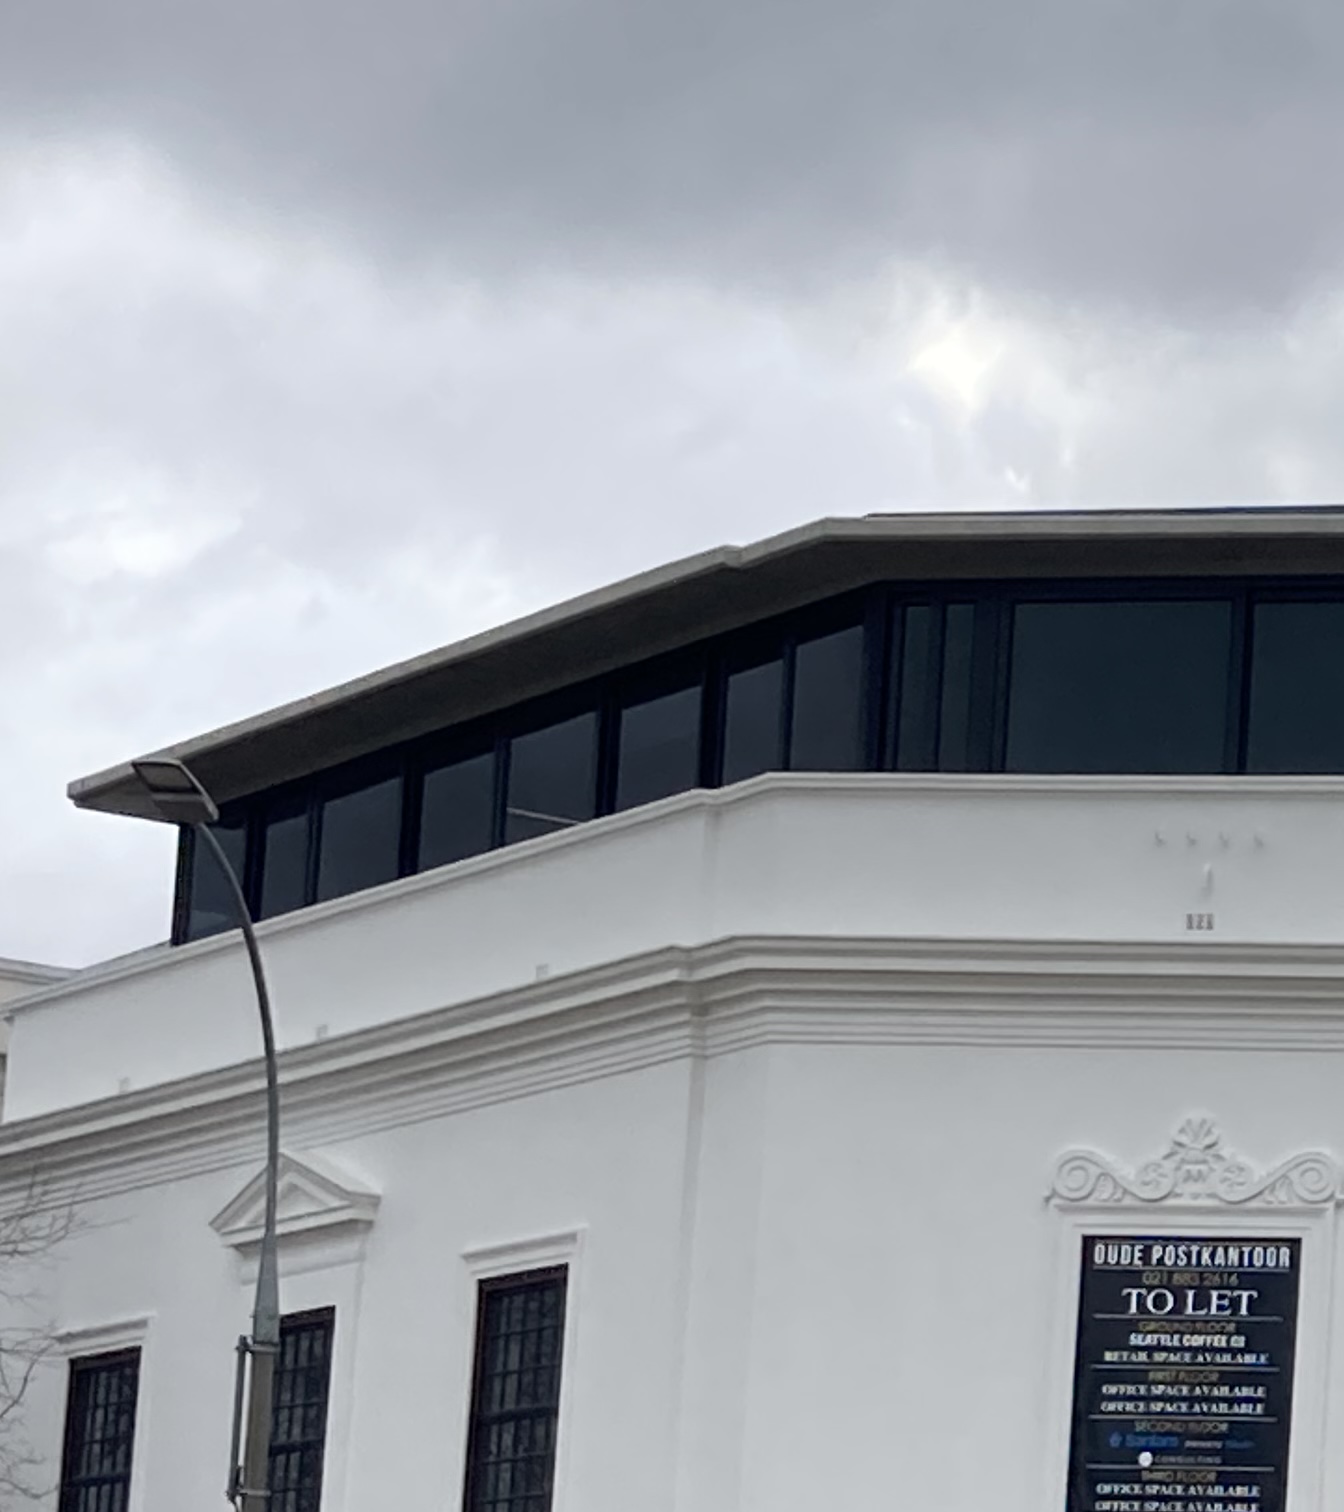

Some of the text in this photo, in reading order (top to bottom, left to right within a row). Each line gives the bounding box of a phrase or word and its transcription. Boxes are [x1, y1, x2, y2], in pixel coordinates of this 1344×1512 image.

[1093, 1243, 1291, 1268] OUDE POSTKANTOOR
[1121, 1288, 1258, 1316] TO LET
[1129, 1333, 1181, 1347] SEATTLE
[1182, 1334, 1228, 1347] COFFEE
[1103, 1350, 1270, 1364] RETAIL SPACE AVAILABLE
[1101, 1384, 1267, 1398] OFFICE SPACE AVAILABLE
[1100, 1401, 1265, 1414] OFFICE SPACE AVAILABLE
[1095, 1483, 1261, 1497] OFFICE SPACE AVAILABLE
[1094, 1500, 1141, 1511] OFFICE
[1143, 1501, 1184, 1512] SPACE
